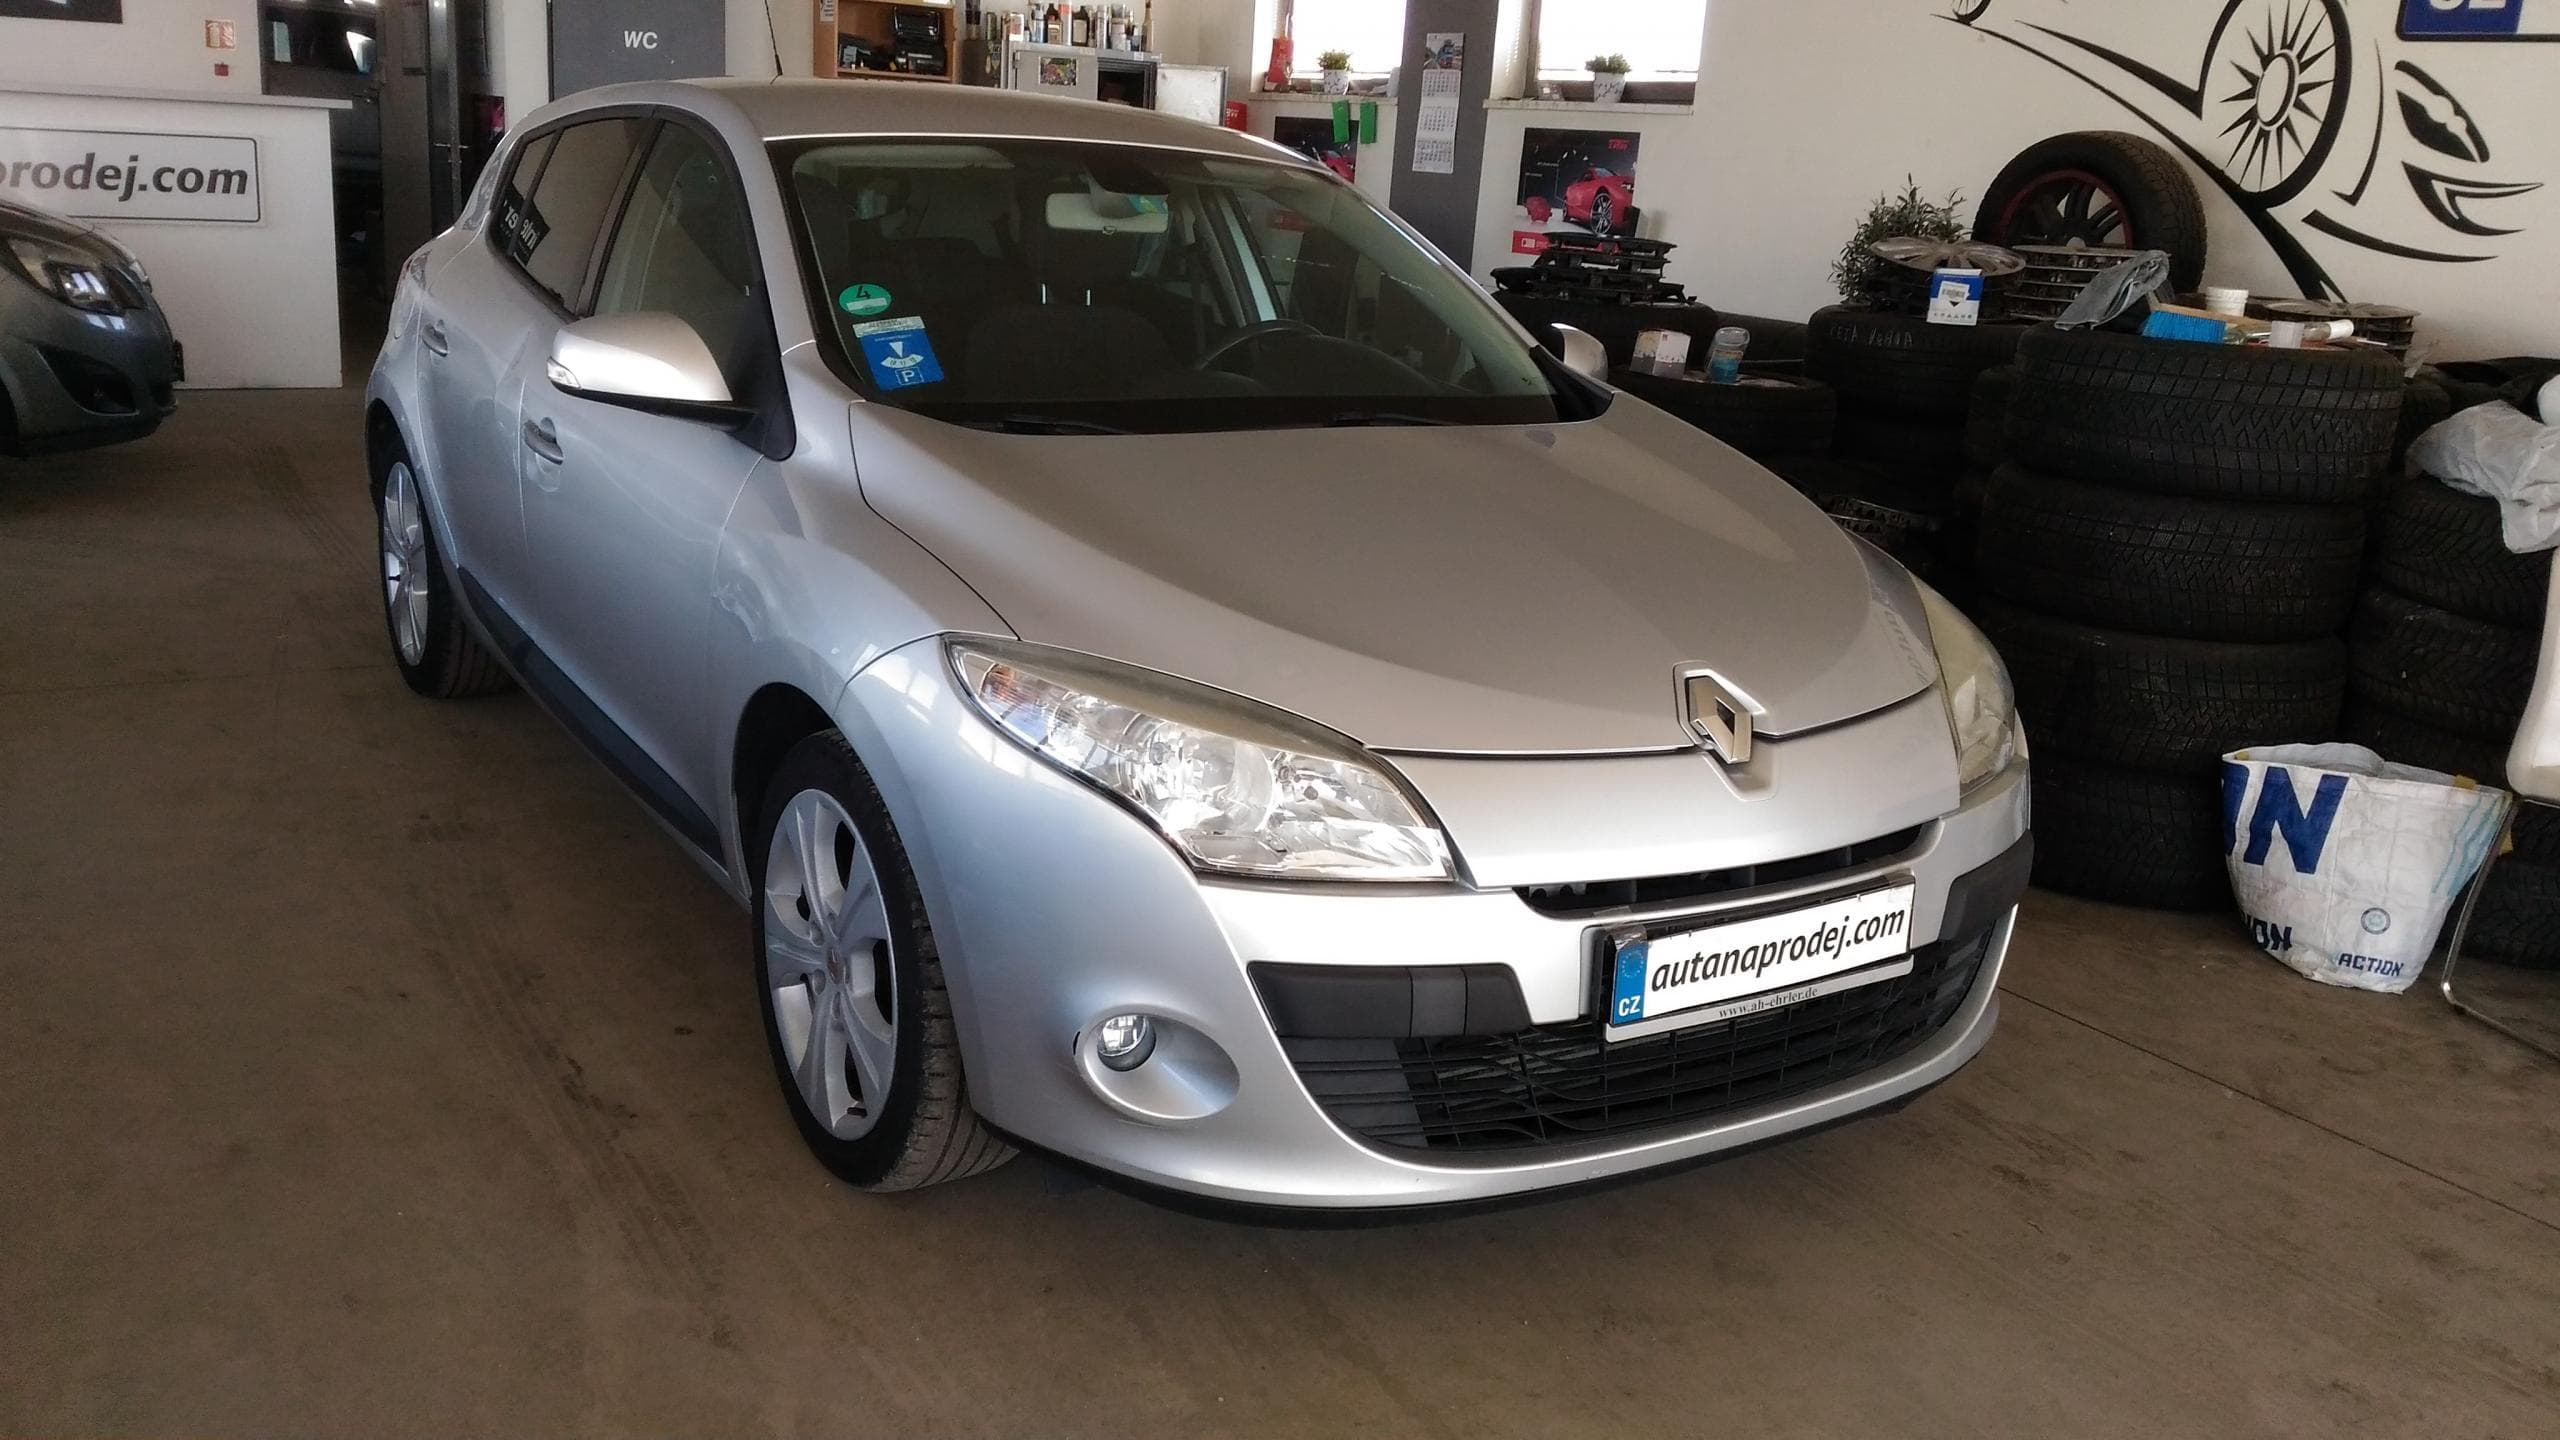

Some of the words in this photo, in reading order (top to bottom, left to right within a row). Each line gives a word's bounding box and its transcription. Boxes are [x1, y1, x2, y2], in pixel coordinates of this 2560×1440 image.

[624, 30, 658, 49] WC
[0, 152, 249, 202] rodej.com
[856, 286, 871, 299] 4
[901, 370, 916, 382] P
[1651, 908, 1906, 992] autanaprodej.com
[2338, 953, 2404, 977] ACTION
[1618, 995, 1641, 1017] CZ
